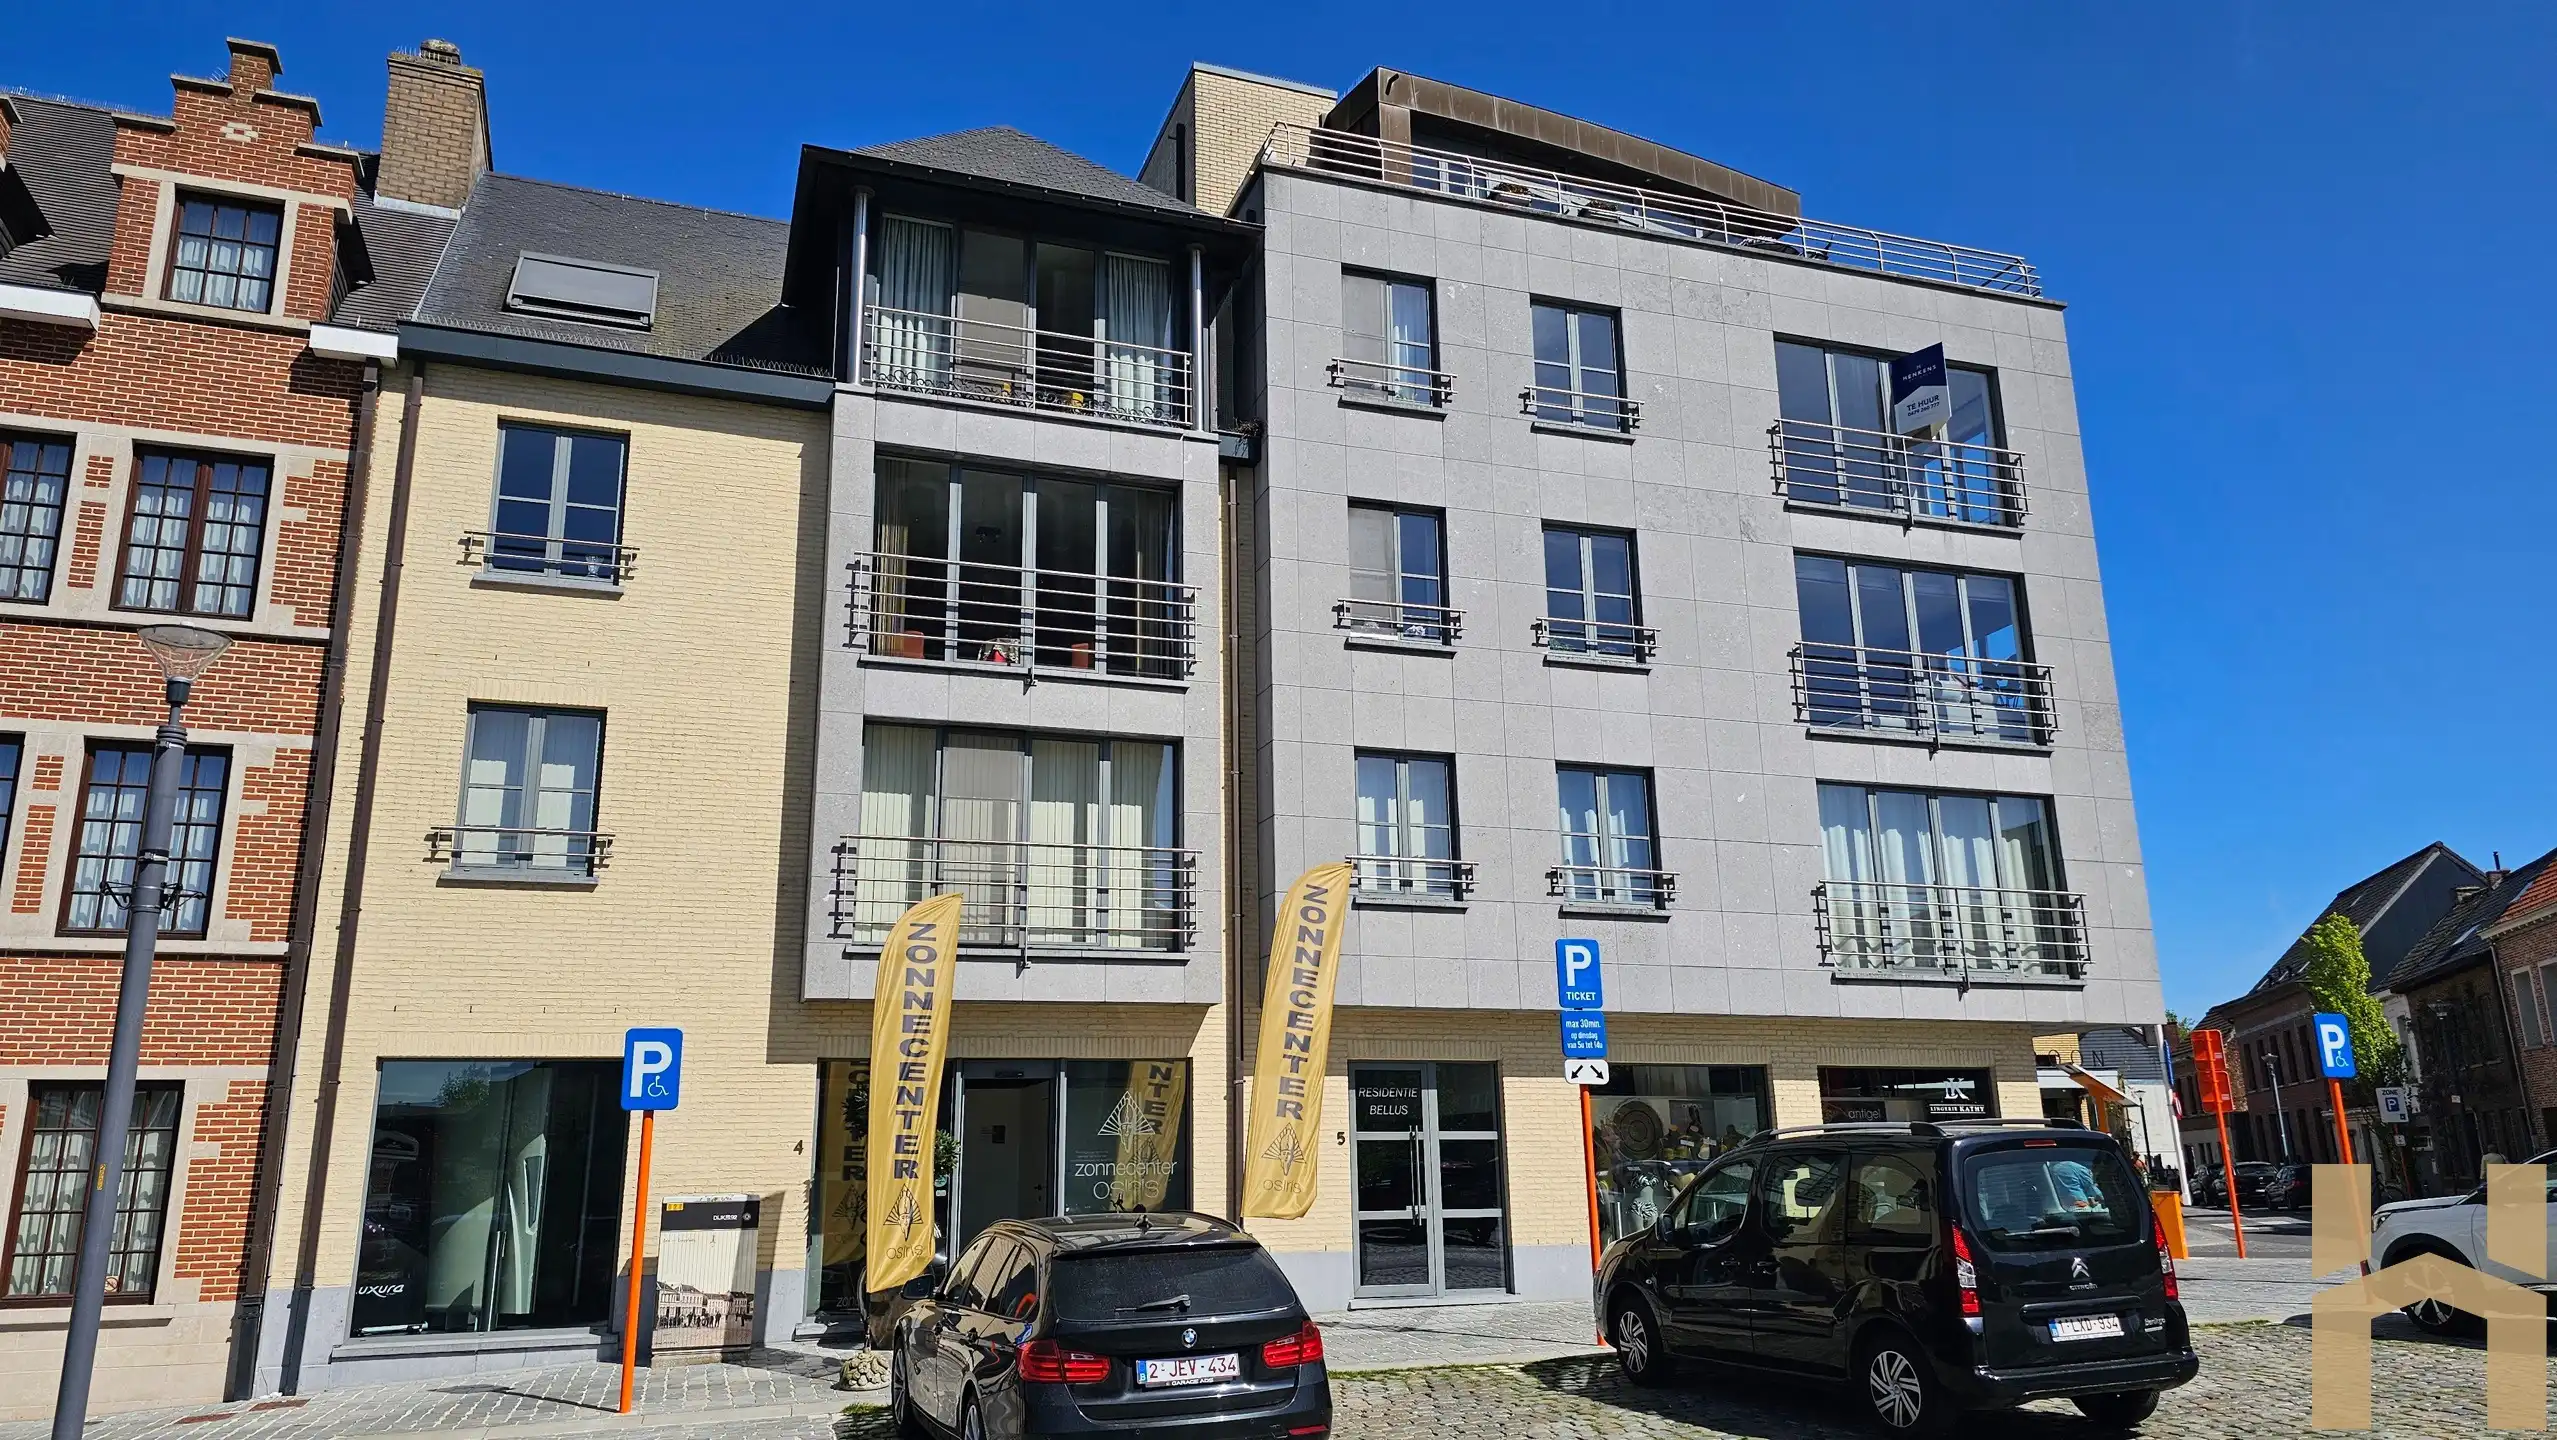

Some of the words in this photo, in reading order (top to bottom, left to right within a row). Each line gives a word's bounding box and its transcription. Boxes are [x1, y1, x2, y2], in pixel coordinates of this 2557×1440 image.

[1902, 365, 1937, 381] HENKENS
[1907, 402, 1916, 411] TE
[1918, 395, 1939, 407] HUUR
[1565, 945, 1592, 987] P
[1276, 884, 1329, 1121] ZONNECENTER
[1566, 991, 1597, 1001] TICKET
[1566, 1020, 1579, 1028] max
[894, 923, 938, 1179] ZONNECENTER
[2320, 1023, 2346, 1067] P
[630, 1041, 673, 1098] P
[1358, 1087, 1418, 1098] RESIDENTIE
[1369, 1104, 1409, 1116] BELLUS
[1849, 1107, 1880, 1121] antigel
[1336, 1131, 1346, 1146] 5
[793, 1139, 804, 1156] 4
[1074, 1161, 1178, 1177] zonnecenter
[355, 1284, 405, 1298] uxura
